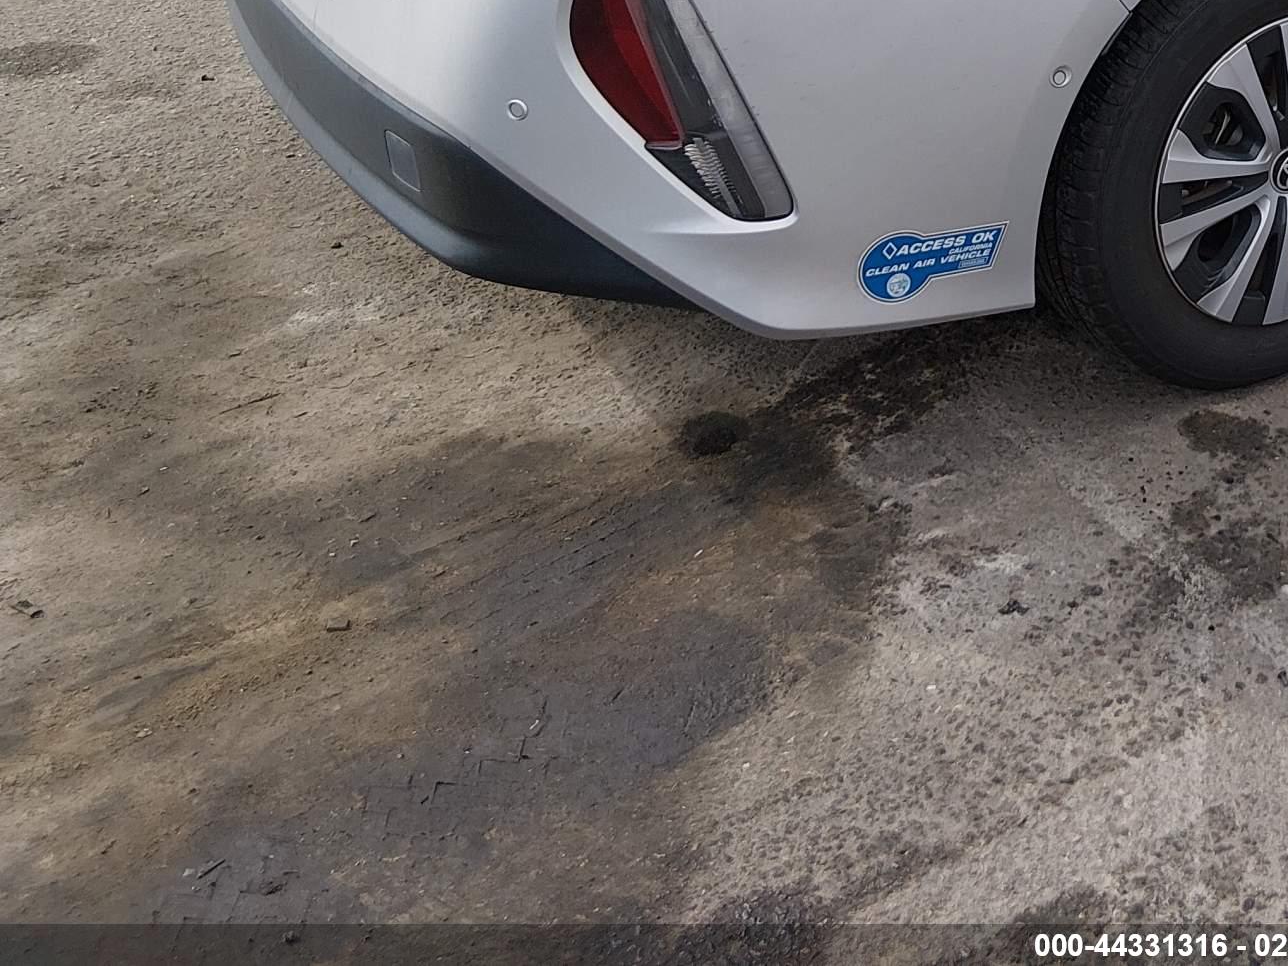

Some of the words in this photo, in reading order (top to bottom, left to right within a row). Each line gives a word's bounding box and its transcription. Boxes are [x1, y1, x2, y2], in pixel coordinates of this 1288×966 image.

[896, 235, 966, 256] ACCESS
[971, 230, 998, 243] OK
[949, 242, 993, 255] CALIFORNIA
[865, 263, 910, 277] CLEAN
[912, 258, 936, 269] AIR
[940, 248, 991, 264] VEHICLE
